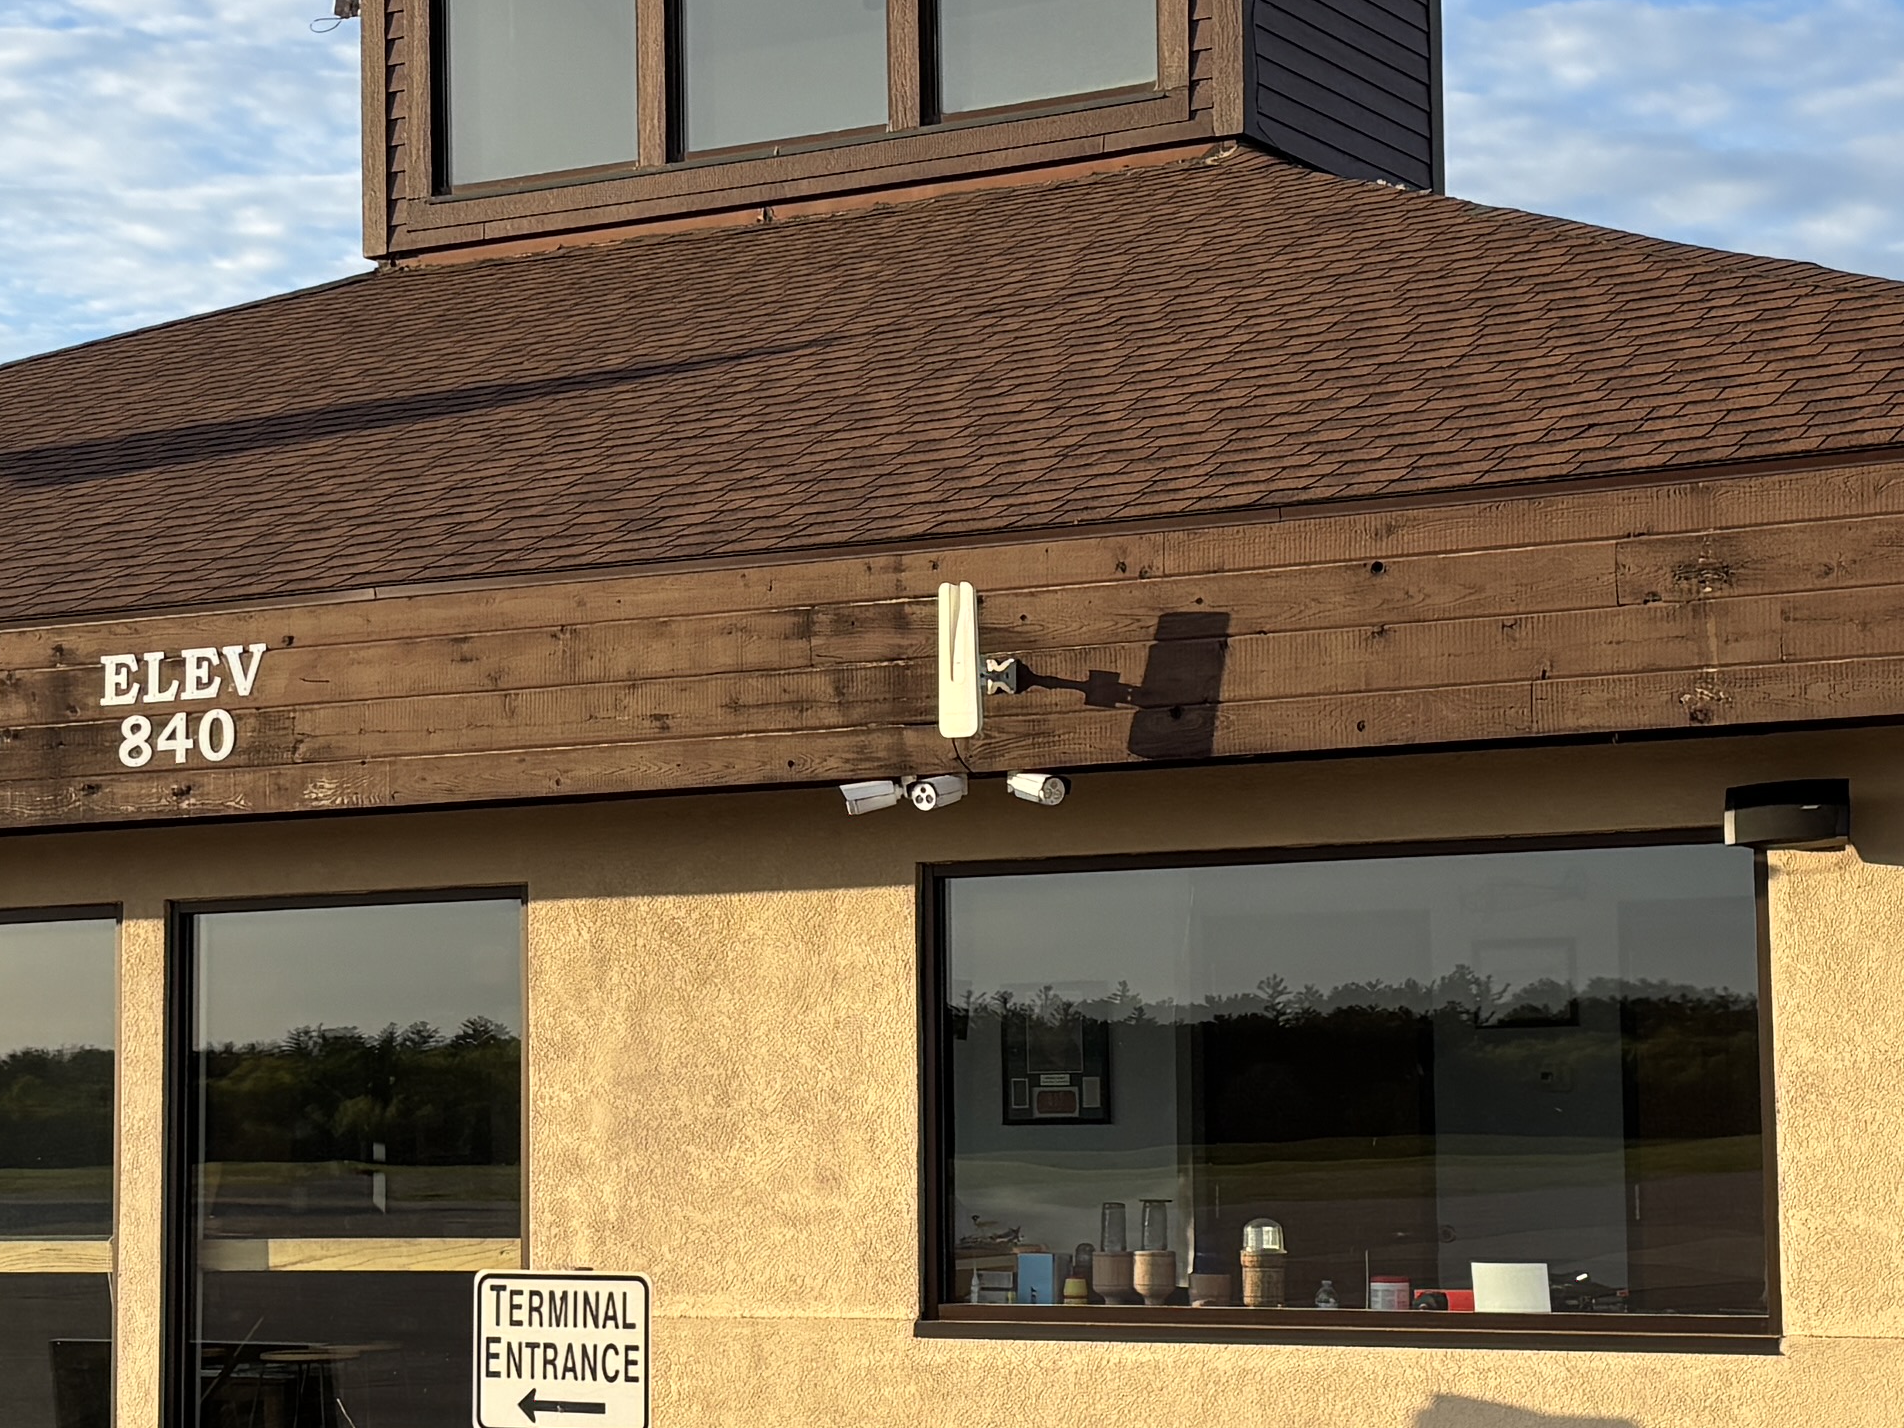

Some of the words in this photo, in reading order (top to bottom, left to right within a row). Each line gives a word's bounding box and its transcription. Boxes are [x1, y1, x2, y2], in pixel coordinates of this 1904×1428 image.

[100, 643, 267, 706] ELEV
[118, 708, 236, 768] 840
[489, 1284, 637, 1330] TERMINAL
[485, 1336, 640, 1383] ENTRANCE
